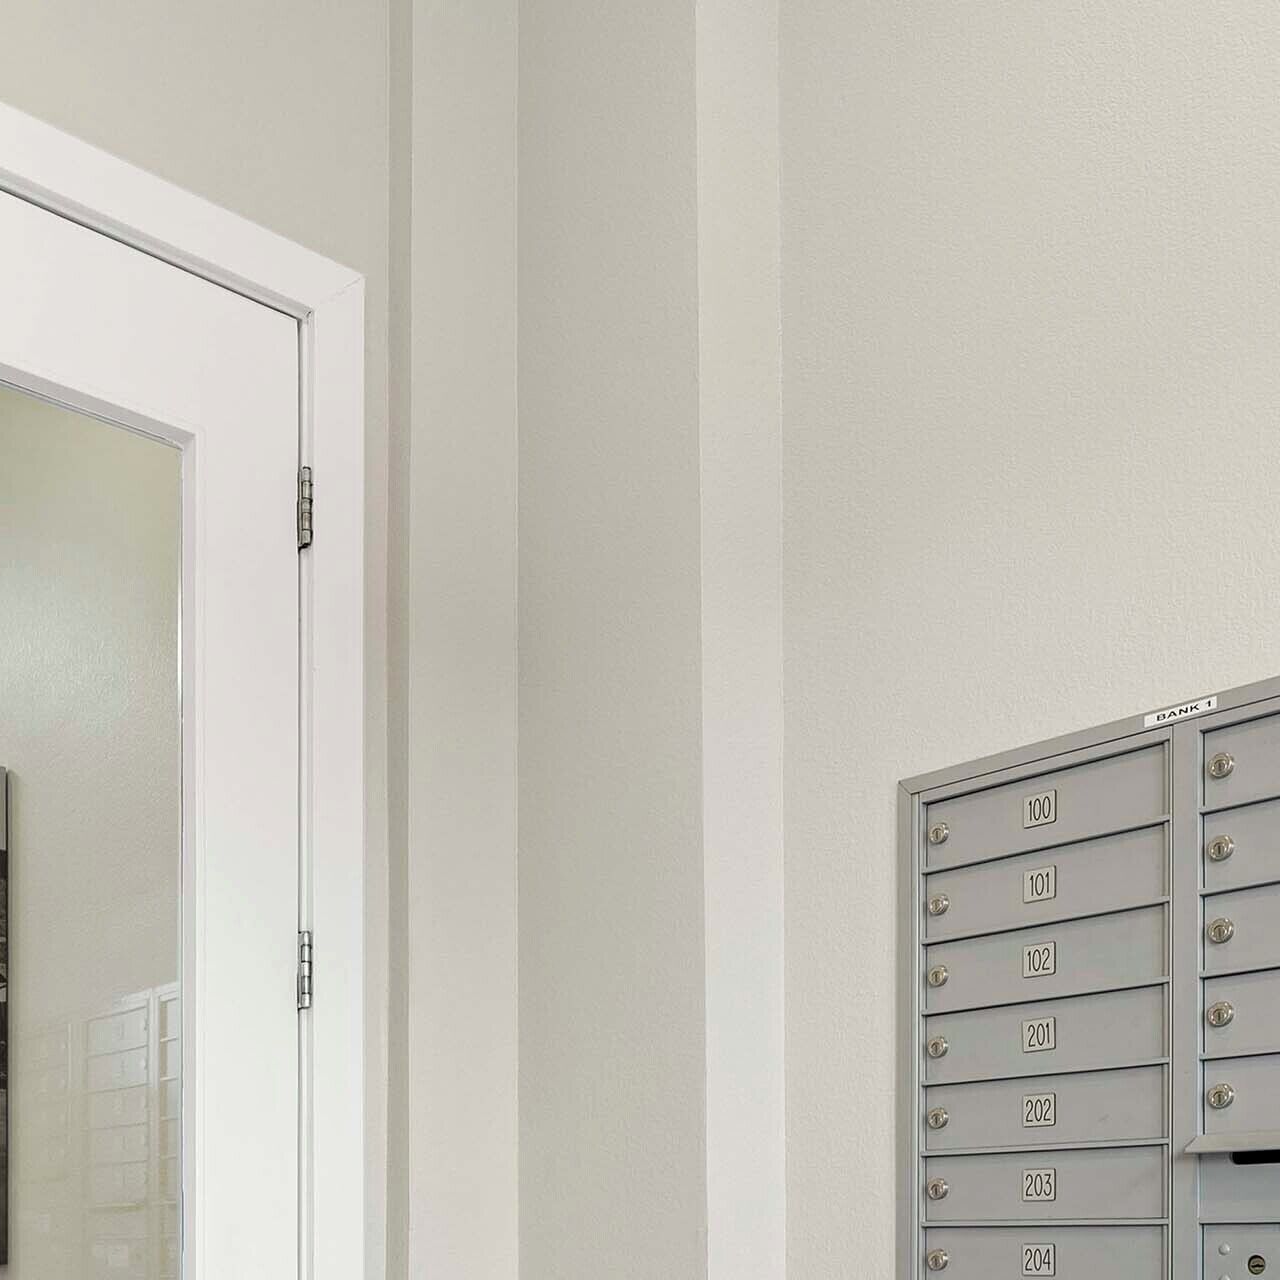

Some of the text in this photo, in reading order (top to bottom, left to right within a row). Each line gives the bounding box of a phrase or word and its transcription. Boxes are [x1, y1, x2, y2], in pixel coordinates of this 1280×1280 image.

[1156, 699, 1212, 722] BANK 1
[1028, 796, 1051, 821] 100
[1029, 871, 1050, 897] 101
[1027, 947, 1050, 972] 102
[1027, 1022, 1050, 1048] 201
[1025, 1098, 1051, 1123] 202
[1025, 1173, 1052, 1197] 203
[1024, 1248, 1051, 1272] 204
